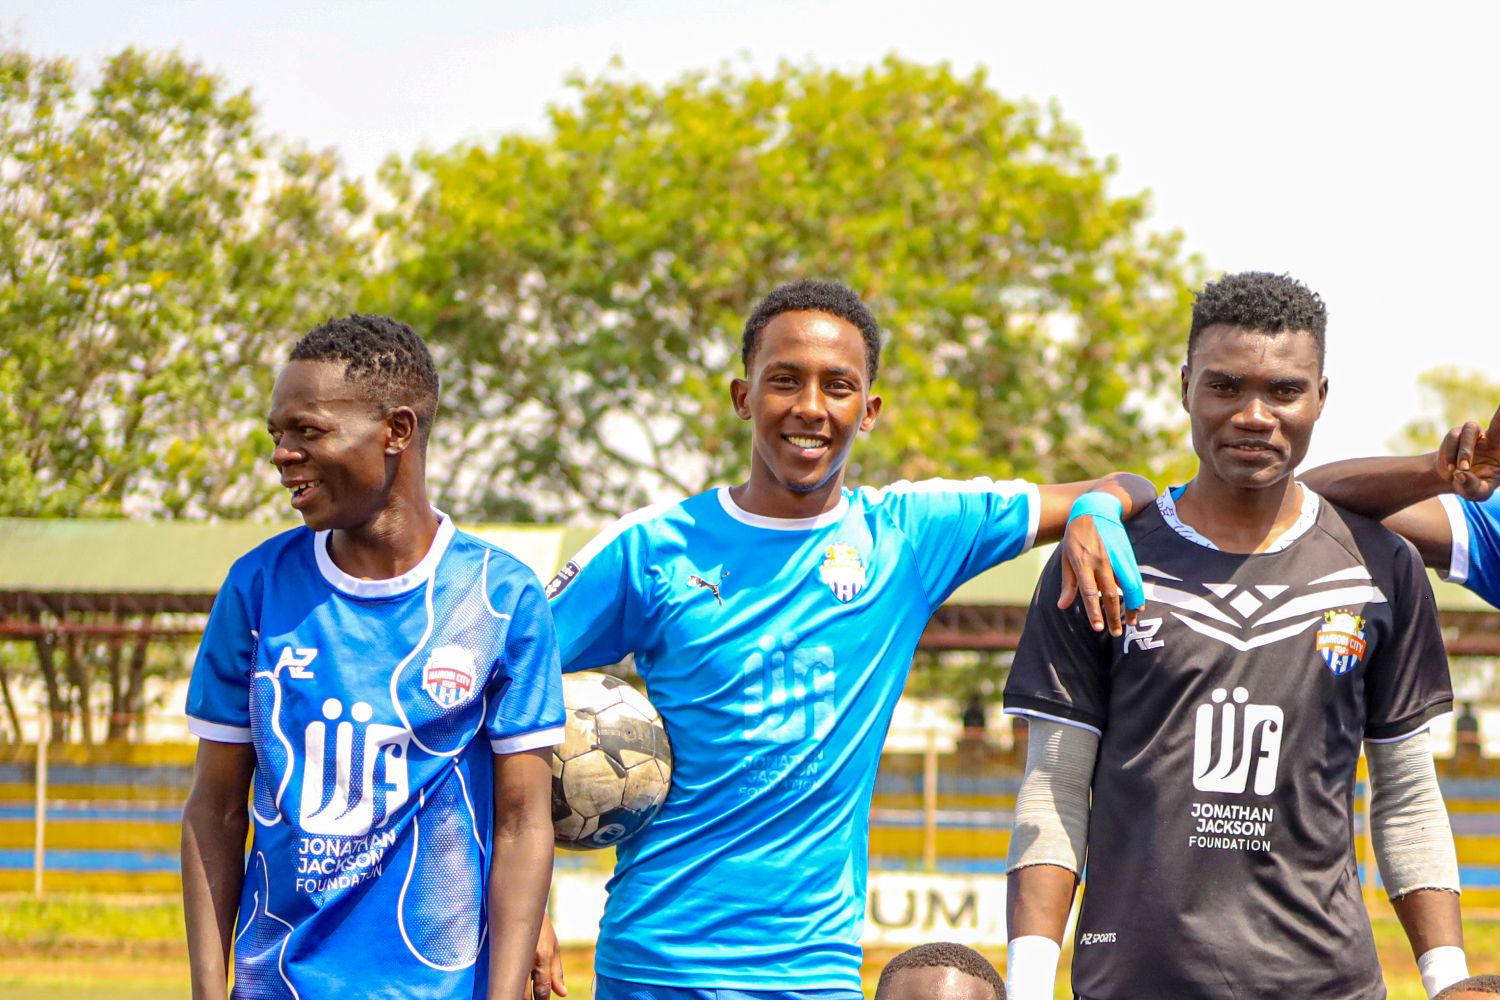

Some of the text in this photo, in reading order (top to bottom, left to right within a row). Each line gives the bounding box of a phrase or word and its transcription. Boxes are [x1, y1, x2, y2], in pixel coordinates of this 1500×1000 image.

[1123, 616, 1164, 654] AZ
[274, 647, 318, 679] AZ
[1191, 803, 1274, 822] JONATHAN
[1196, 818, 1266, 837] JACKSON
[298, 829, 397, 856] JONATHAN
[1189, 835, 1271, 852] FOUNDATION
[297, 848, 384, 875] JACKSON
